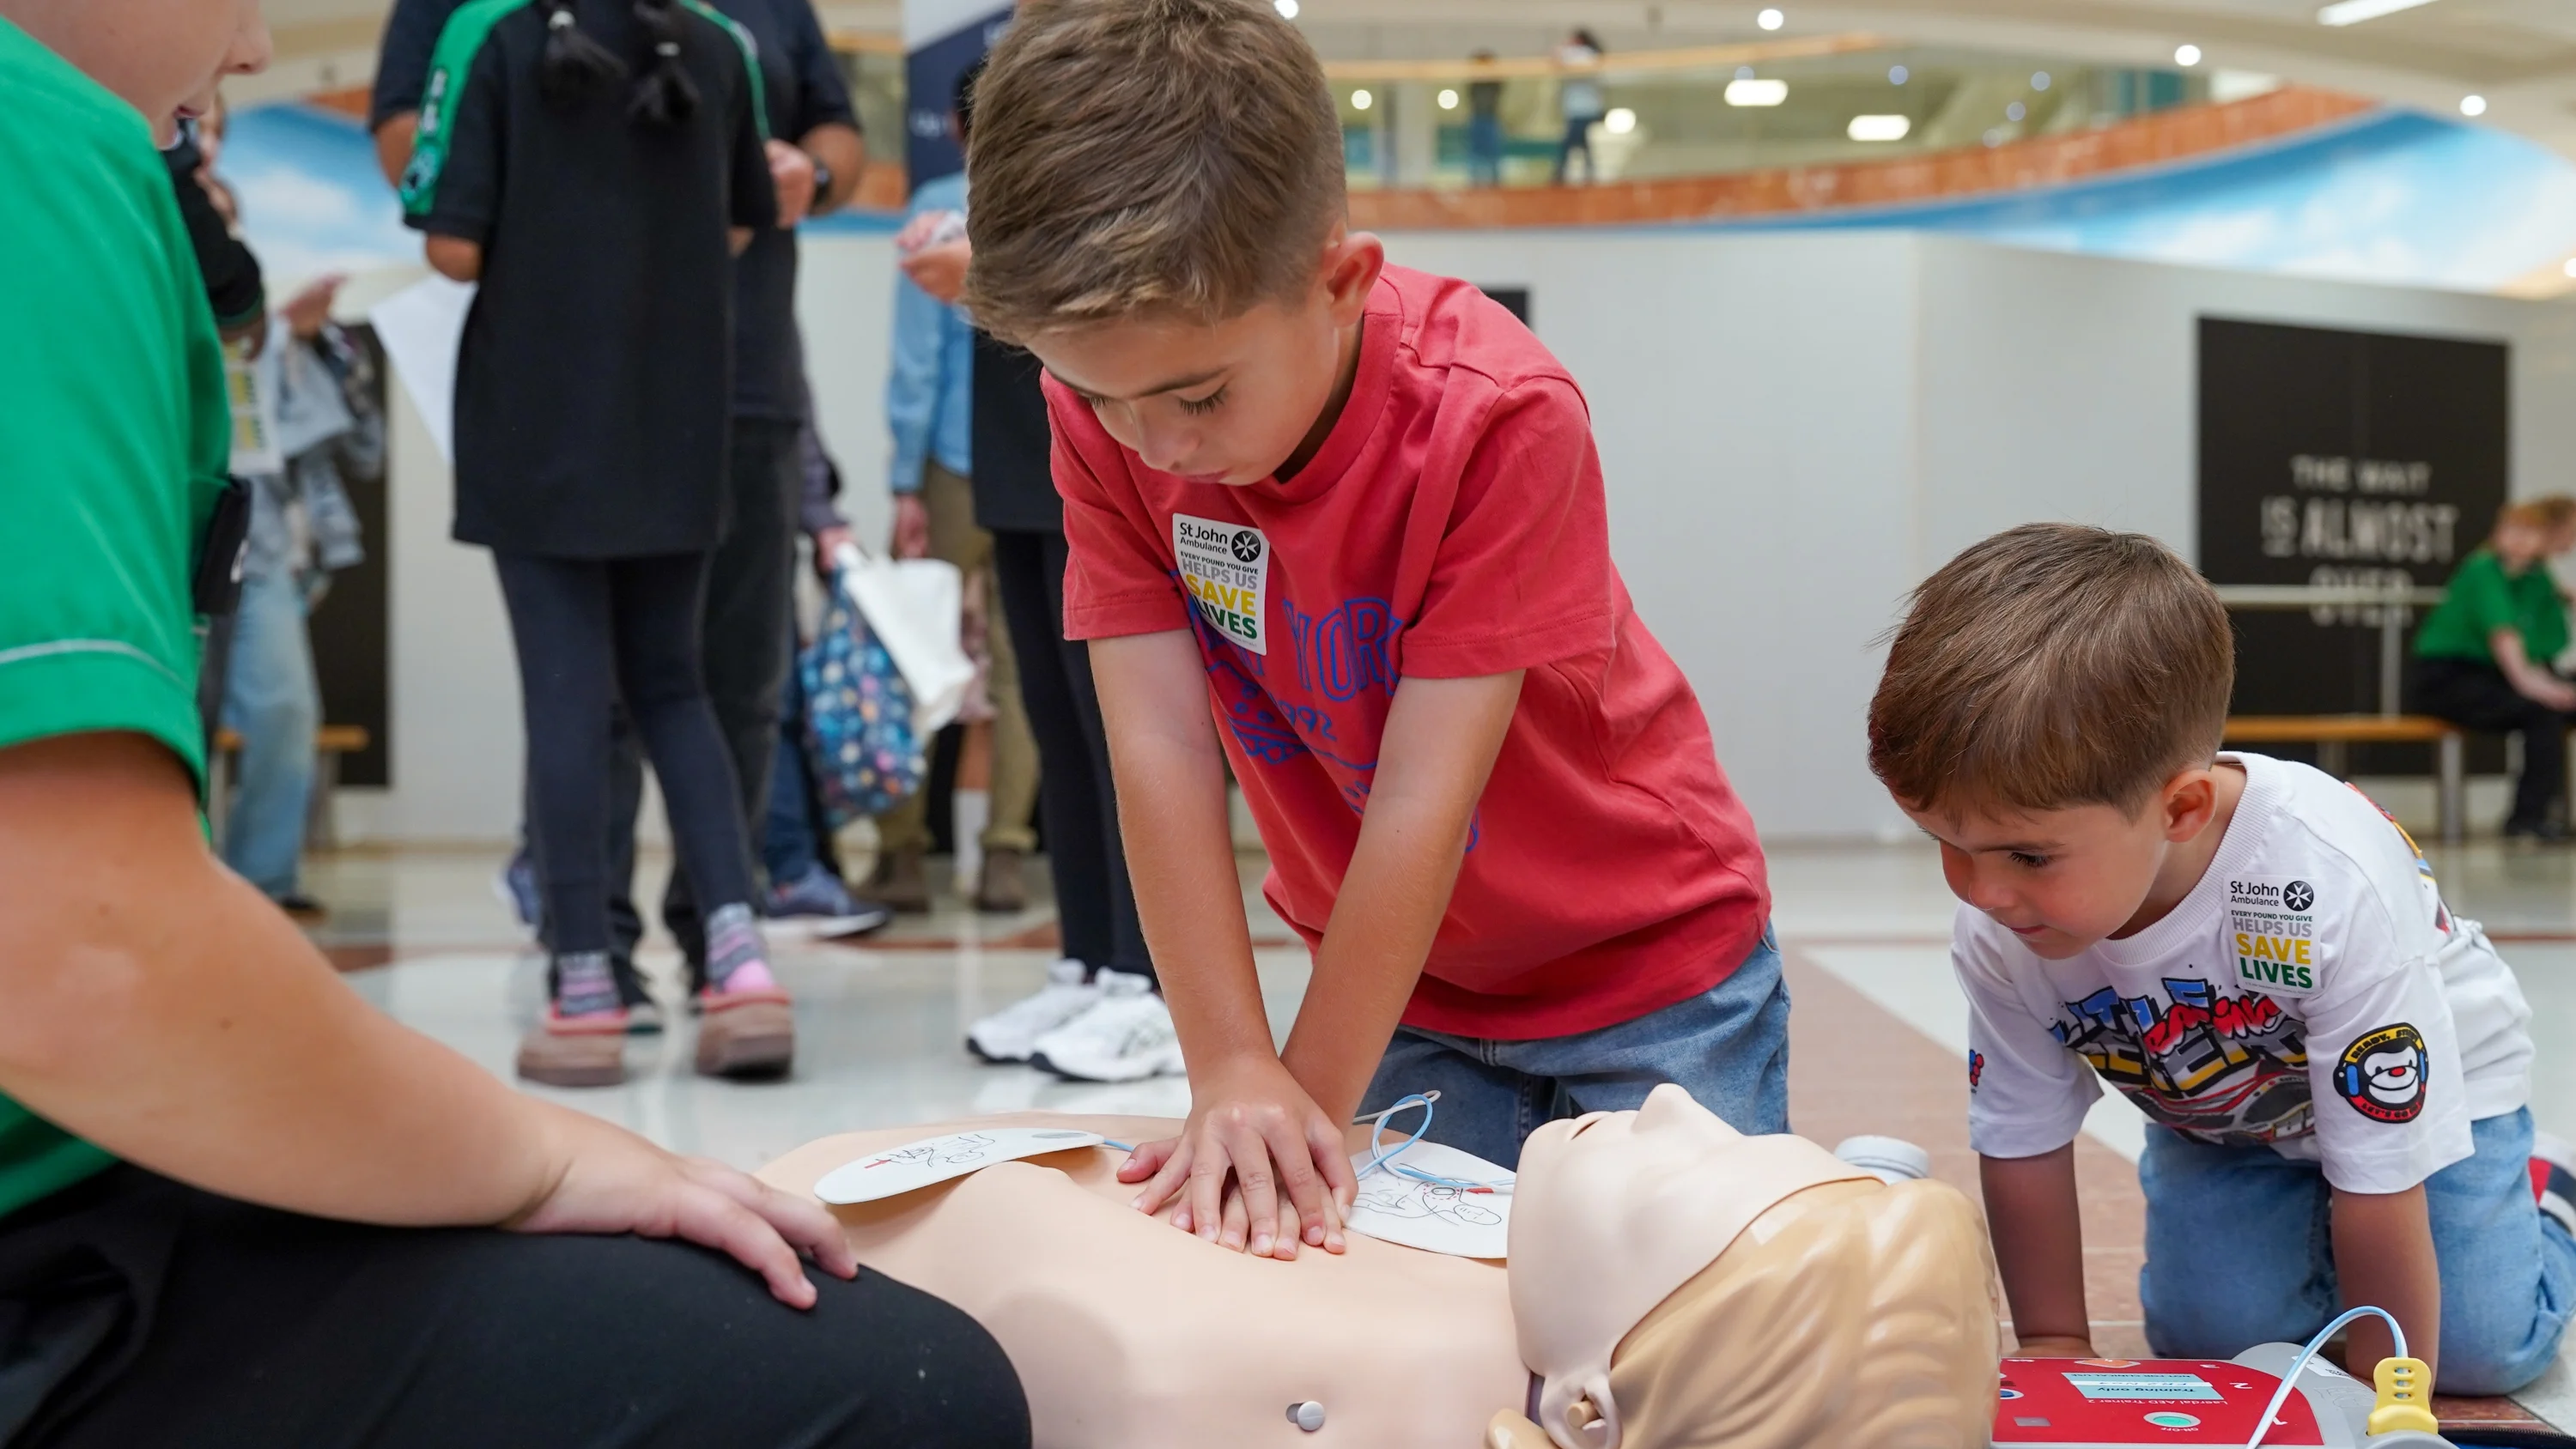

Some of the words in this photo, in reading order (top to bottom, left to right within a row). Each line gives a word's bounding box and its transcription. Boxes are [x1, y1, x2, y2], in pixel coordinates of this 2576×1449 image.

[1179, 522, 1193, 537] St
[1195, 525, 1228, 545] John
[1180, 537, 1227, 555] Ambulance
[1181, 550, 1200, 561] EVERY
[1202, 557, 1225, 567] POUND
[1226, 562, 1241, 572] YOU
[1242, 566, 1259, 575] GIVE
[1182, 559, 1230, 585] HELPS
[1235, 573, 1257, 590] US
[1185, 573, 1256, 616] SAVE
[1193, 594, 1258, 640] LIVES
[2230, 880, 2244, 894] St
[2246, 882, 2280, 897] John
[2230, 894, 2280, 906] Ambulance
[2231, 909, 2252, 918] EVERY
[2253, 912, 2277, 920] POUND
[2233, 917, 2284, 936] HELPS
[2288, 922, 2312, 938] US
[2235, 932, 2312, 965] SAVE
[2239, 956, 2313, 989] LIVES
